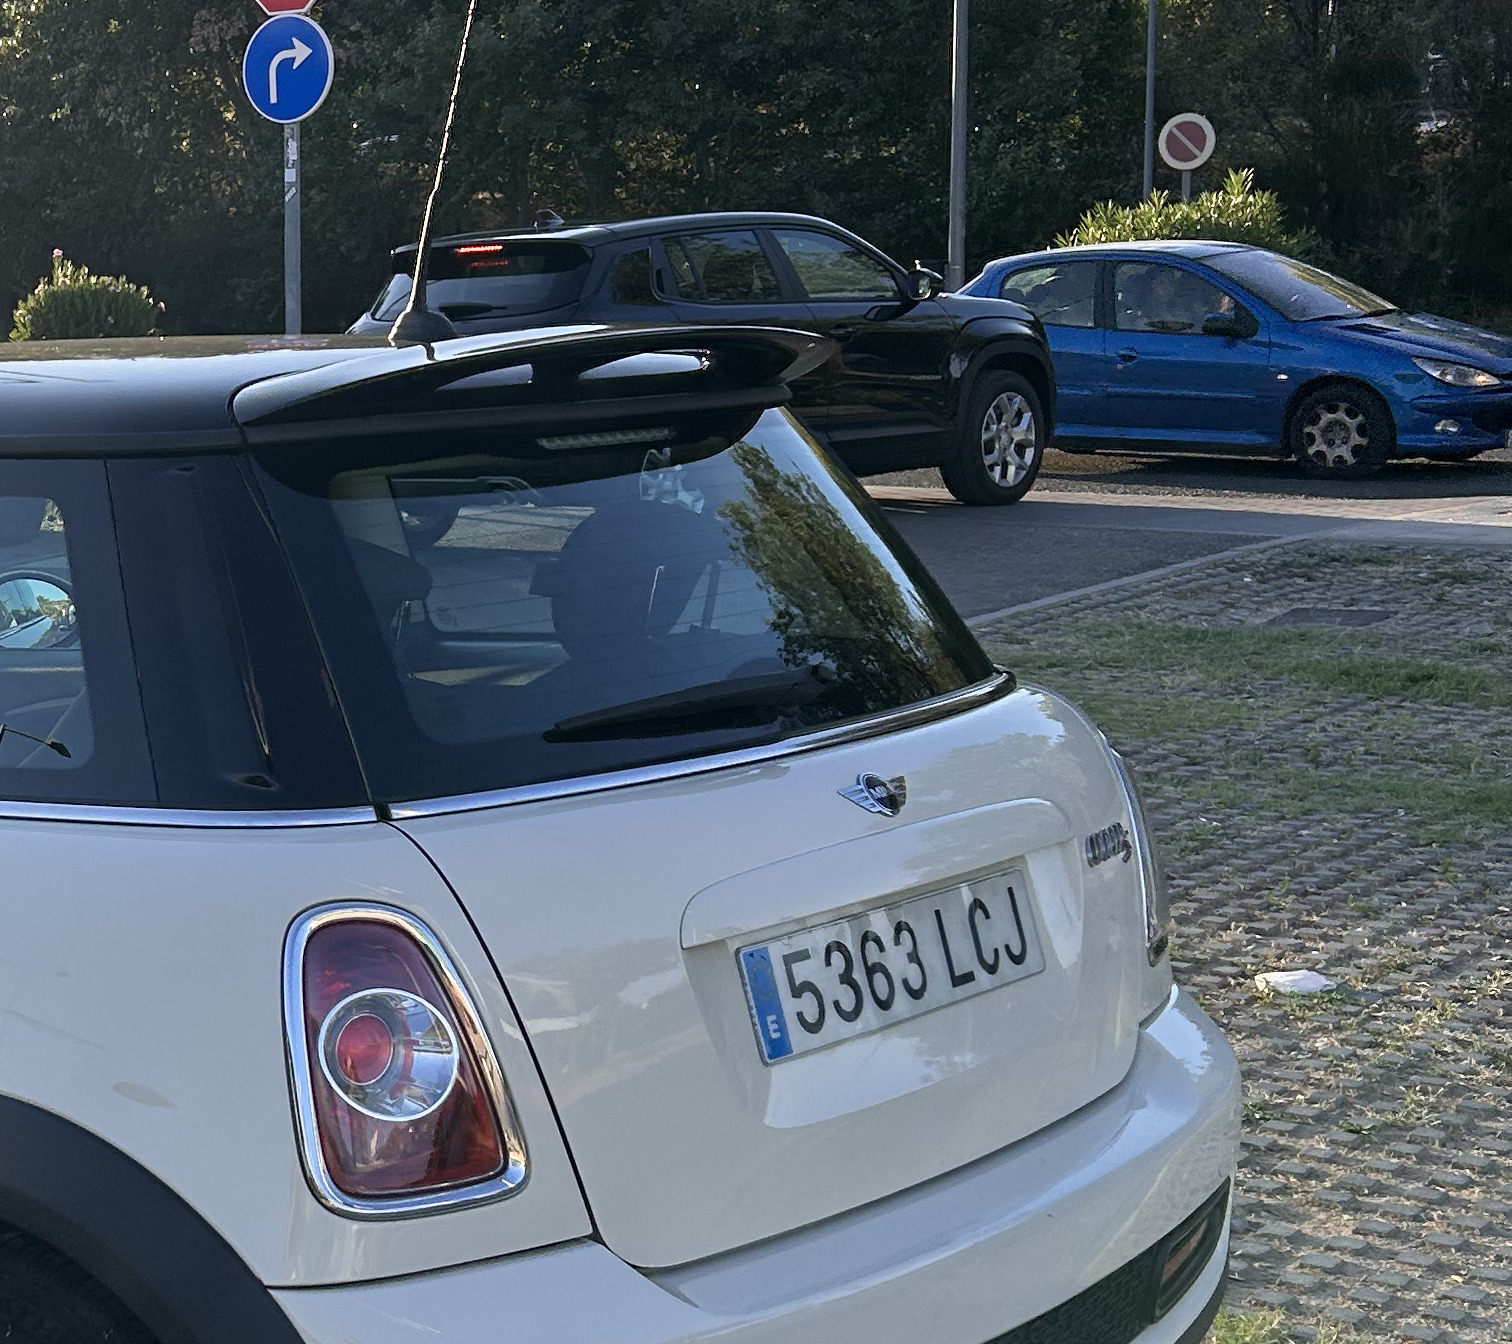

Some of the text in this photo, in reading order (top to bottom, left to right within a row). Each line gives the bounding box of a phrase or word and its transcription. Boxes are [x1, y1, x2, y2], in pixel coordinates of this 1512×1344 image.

[782, 886, 1028, 1034] 5363 LCJ
[766, 1014, 782, 1039] E
